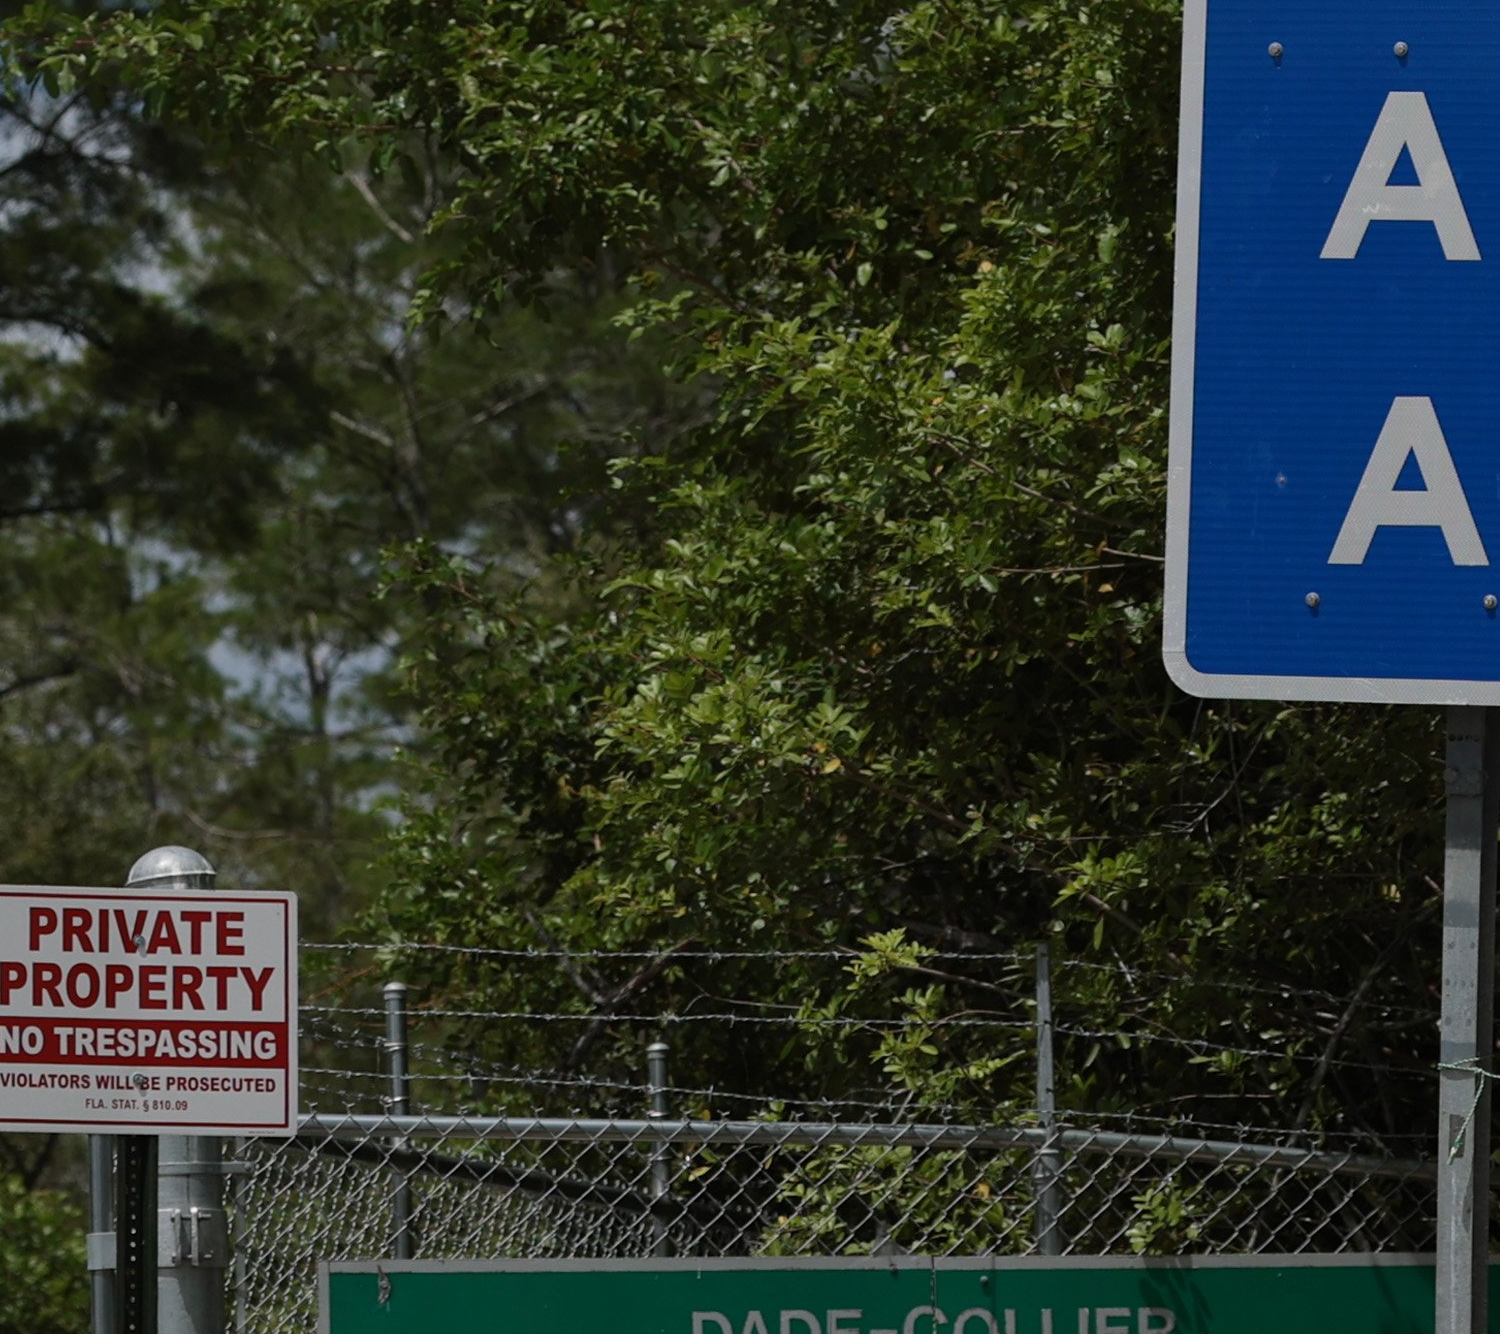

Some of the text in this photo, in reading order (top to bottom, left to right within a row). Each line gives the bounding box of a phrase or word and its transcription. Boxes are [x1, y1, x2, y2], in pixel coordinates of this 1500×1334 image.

[29, 907, 245, 955] PRIVATE
[0, 962, 275, 1011] PROPERTY
[54, 1027, 278, 1060] TRESPASSING
[0, 1073, 276, 1093] VIOLATORS WILL BE PROSECUTED
[85, 1098, 108, 1110] FLA.
[111, 1099, 139, 1110] STAT.
[152, 1100, 188, 1111] 810.09
